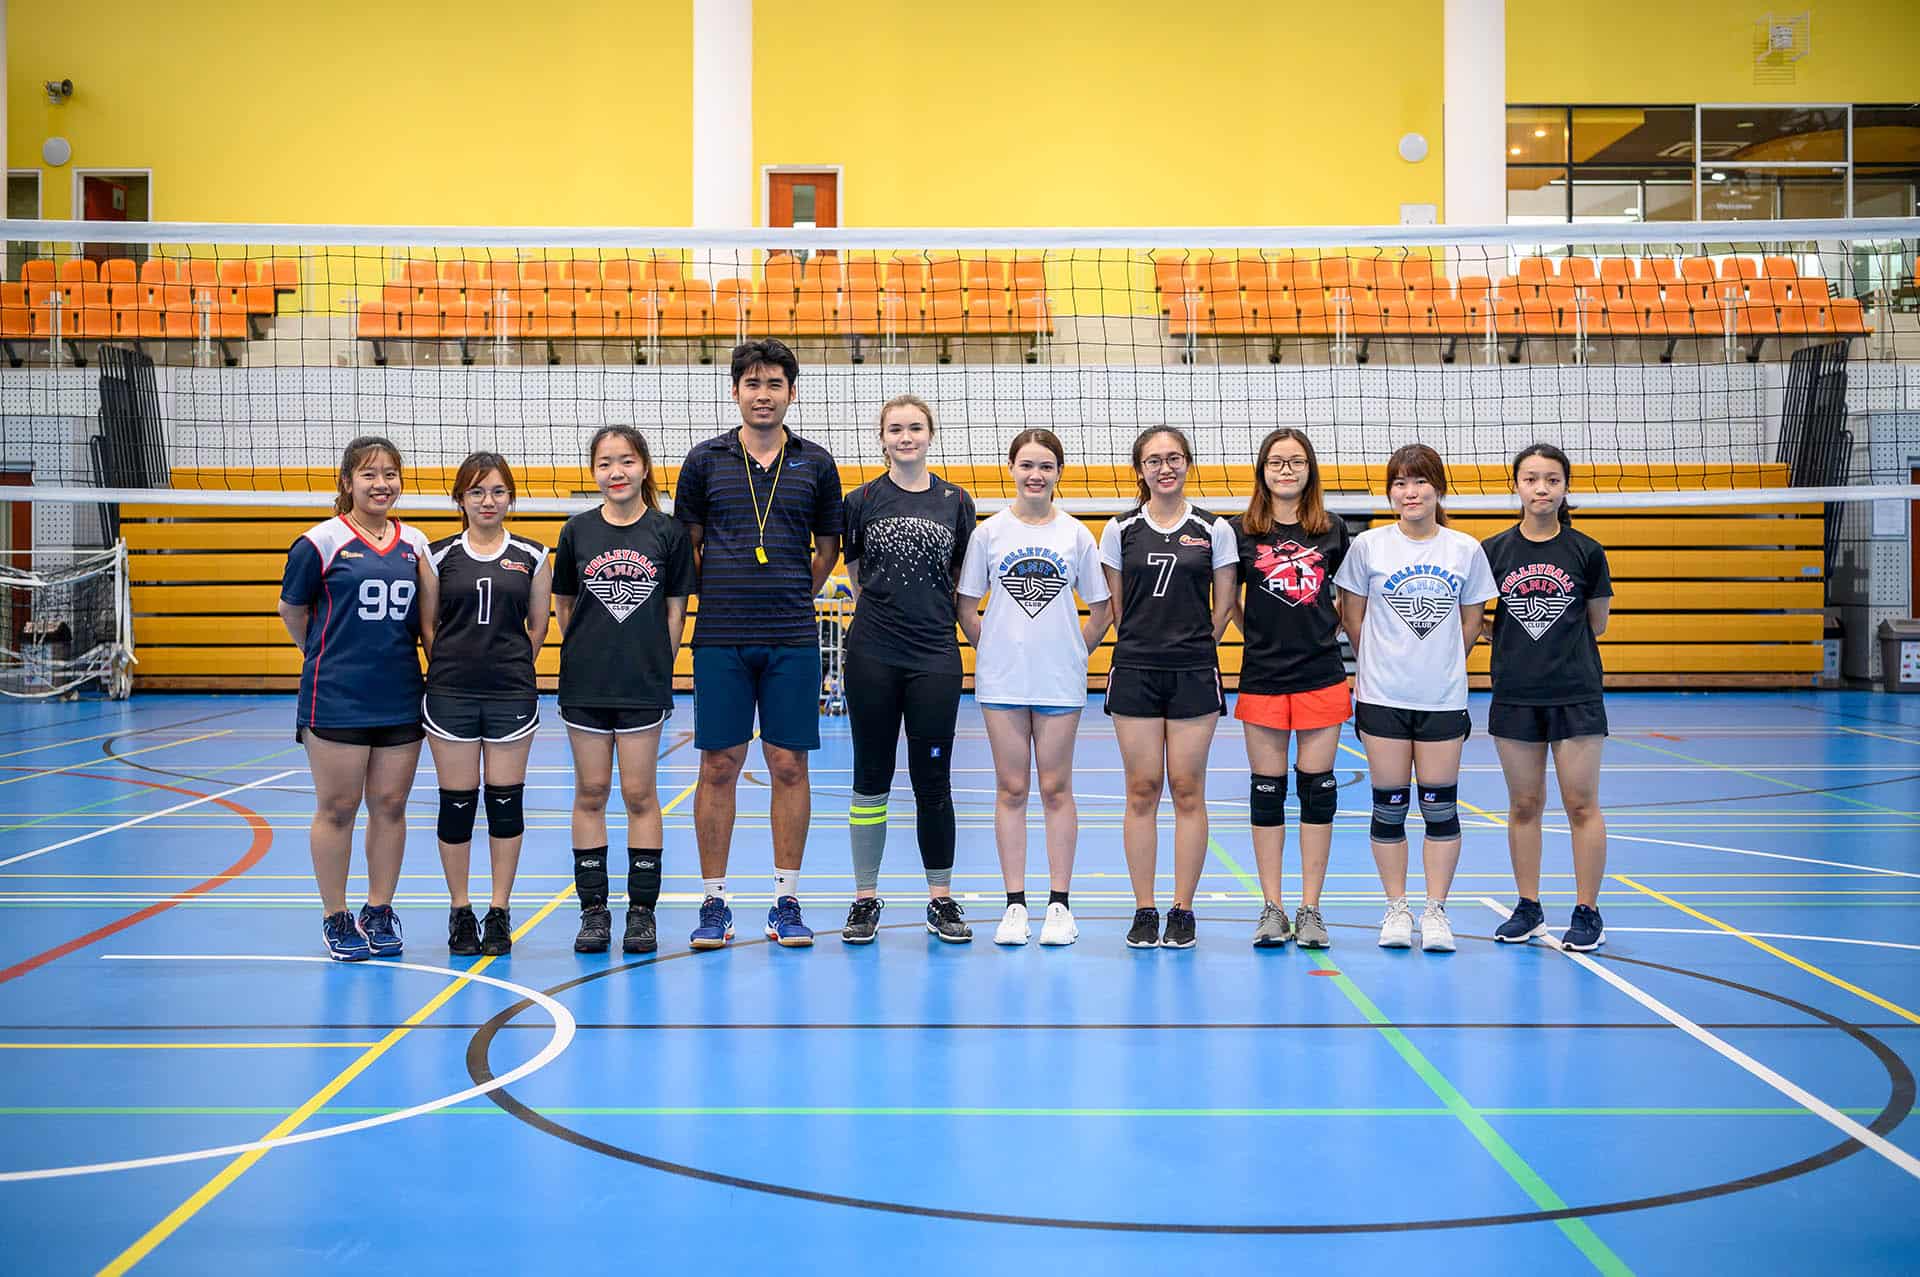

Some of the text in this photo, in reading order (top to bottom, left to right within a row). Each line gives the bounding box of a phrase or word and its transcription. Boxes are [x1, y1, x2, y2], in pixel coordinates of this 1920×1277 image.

[584, 549, 657, 577] VOLLEYBALL
[999, 547, 1067, 574] VOLLEYBALL
[1147, 553, 1178, 597] 7
[1269, 578, 1317, 591] RUN
[1384, 565, 1458, 592] VOLLEYBALL
[1501, 563, 1575, 593] VOLLEYBALL
[358, 579, 416, 621] 99
[476, 577, 492, 625] 1
